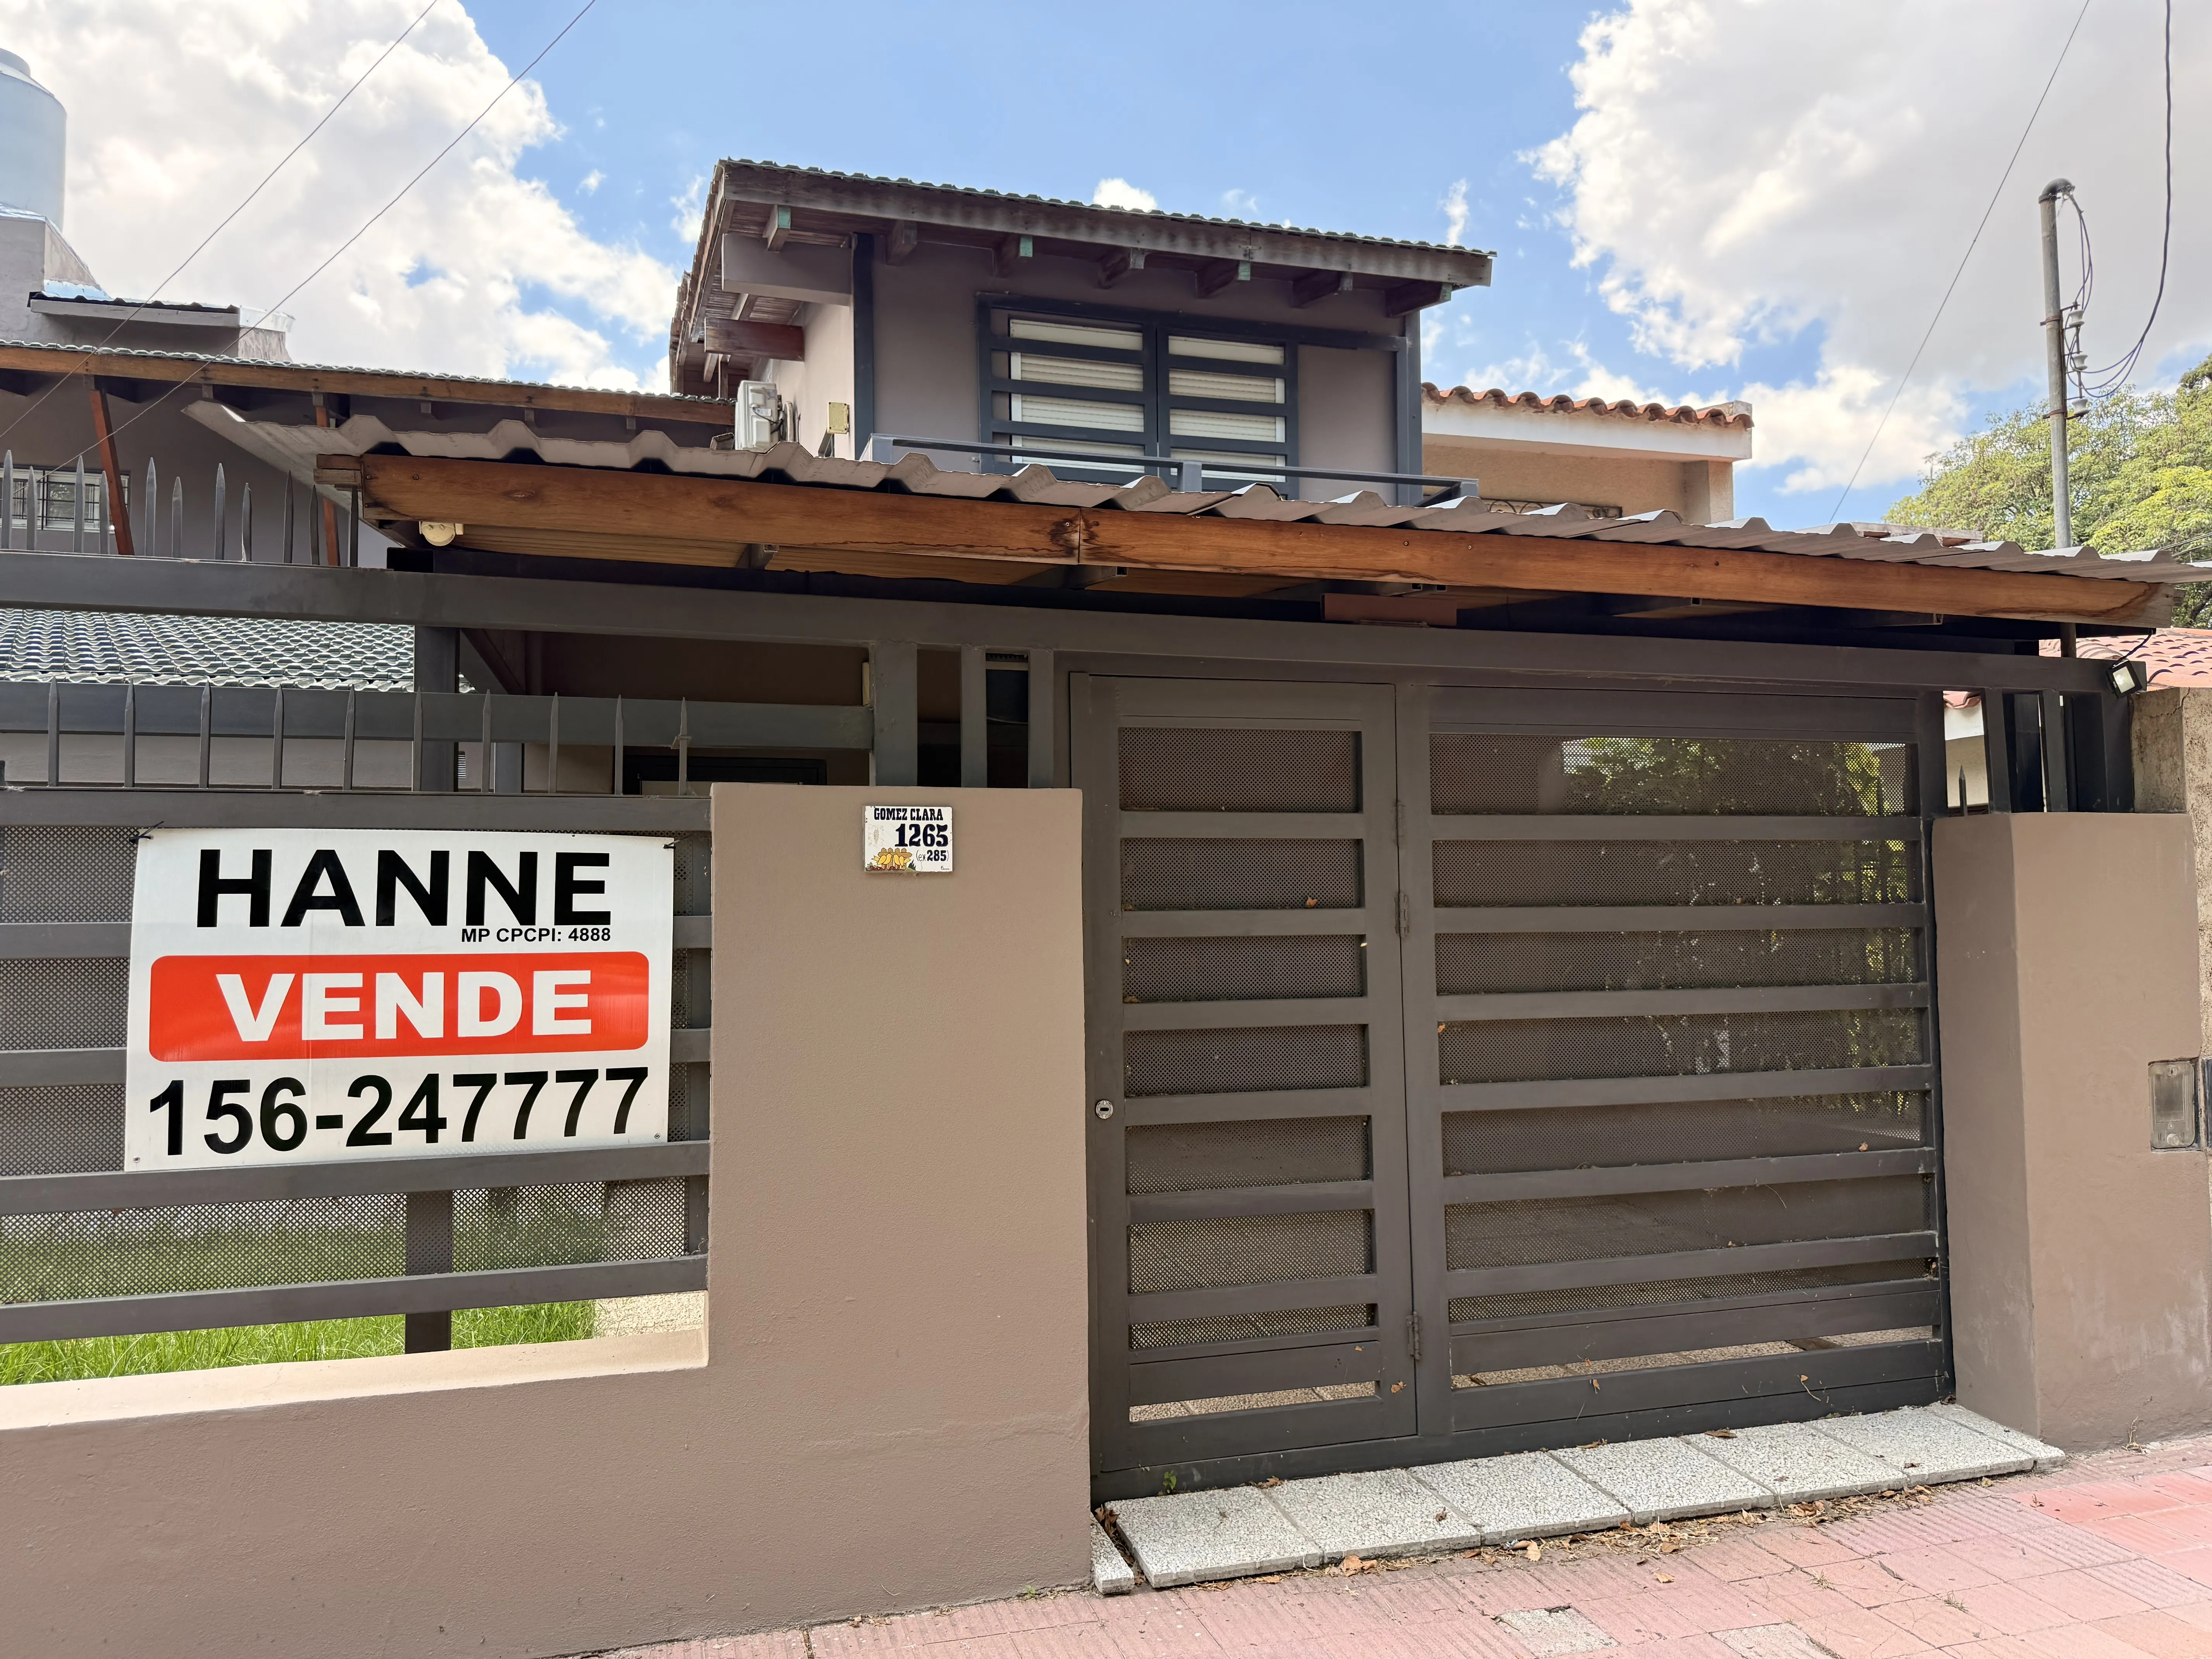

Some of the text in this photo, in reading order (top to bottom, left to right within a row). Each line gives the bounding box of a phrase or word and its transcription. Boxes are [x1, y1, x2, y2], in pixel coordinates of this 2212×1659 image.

[874, 808, 943, 821] GOMEZ CLARA
[895, 823, 948, 847] 1265
[197, 849, 611, 927] HANNE
[461, 927, 611, 942] MP CPCPI: 4888
[216, 970, 592, 1042] VENDE
[149, 1066, 649, 1156] 156-247777
